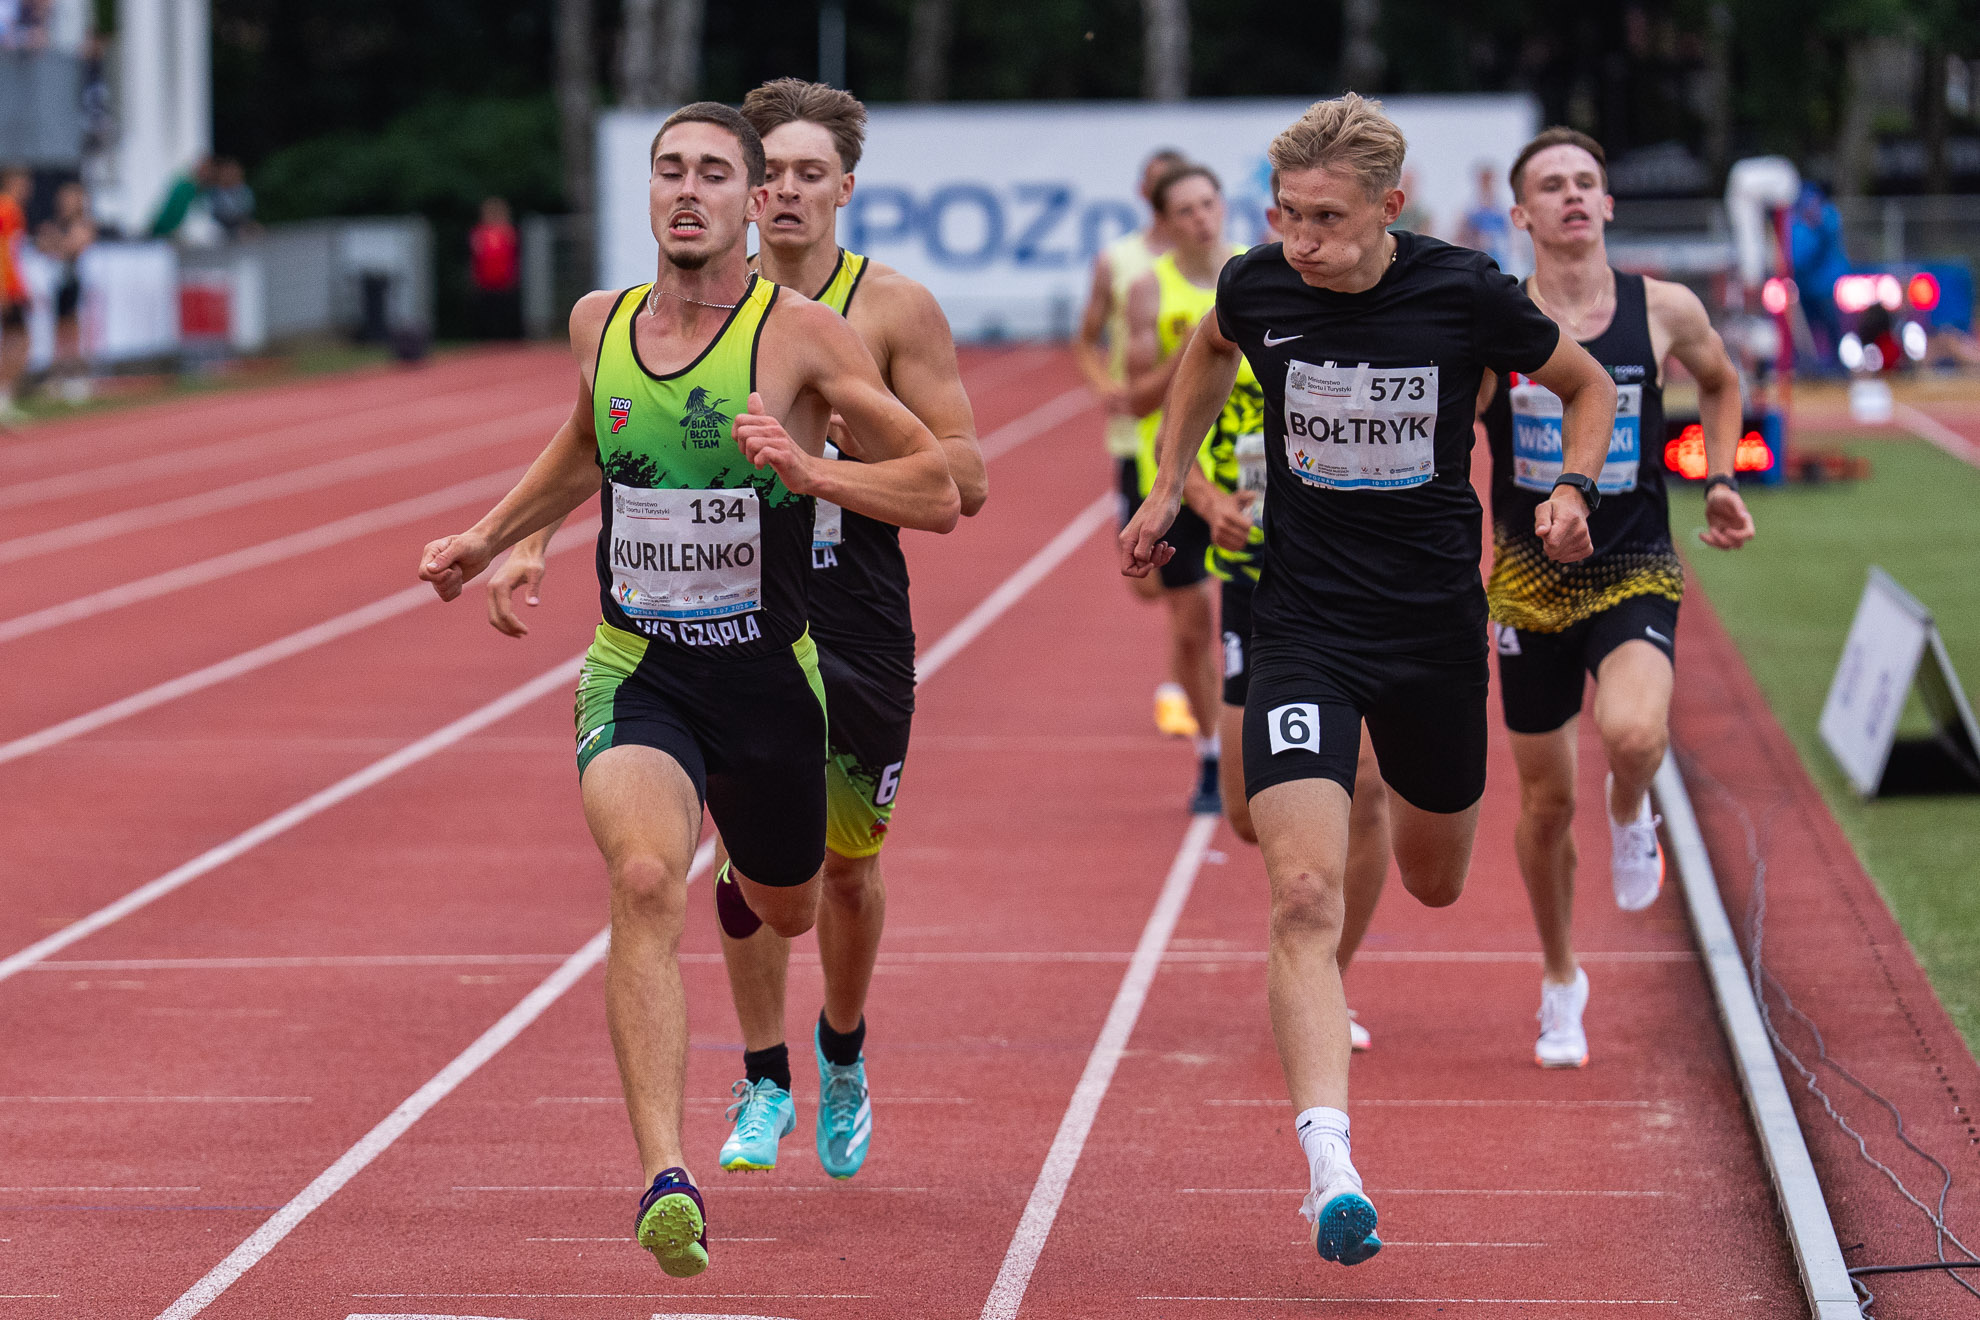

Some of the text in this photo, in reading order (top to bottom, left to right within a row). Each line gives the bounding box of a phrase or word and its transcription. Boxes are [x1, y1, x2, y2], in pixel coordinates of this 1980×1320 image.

[1369, 376, 1425, 401] 573
[611, 397, 631, 410] TICO
[690, 429, 721, 439] BŁOTA
[691, 418, 718, 429] BIAŁE
[1289, 411, 1431, 445] BOŁTRYK
[692, 439, 720, 449] TEAM
[689, 498, 746, 524] 134
[614, 537, 755, 572] KURILENKO
[678, 614, 762, 647] CZAPLA
[1279, 707, 1311, 745] 6
[876, 761, 902, 805] 6
